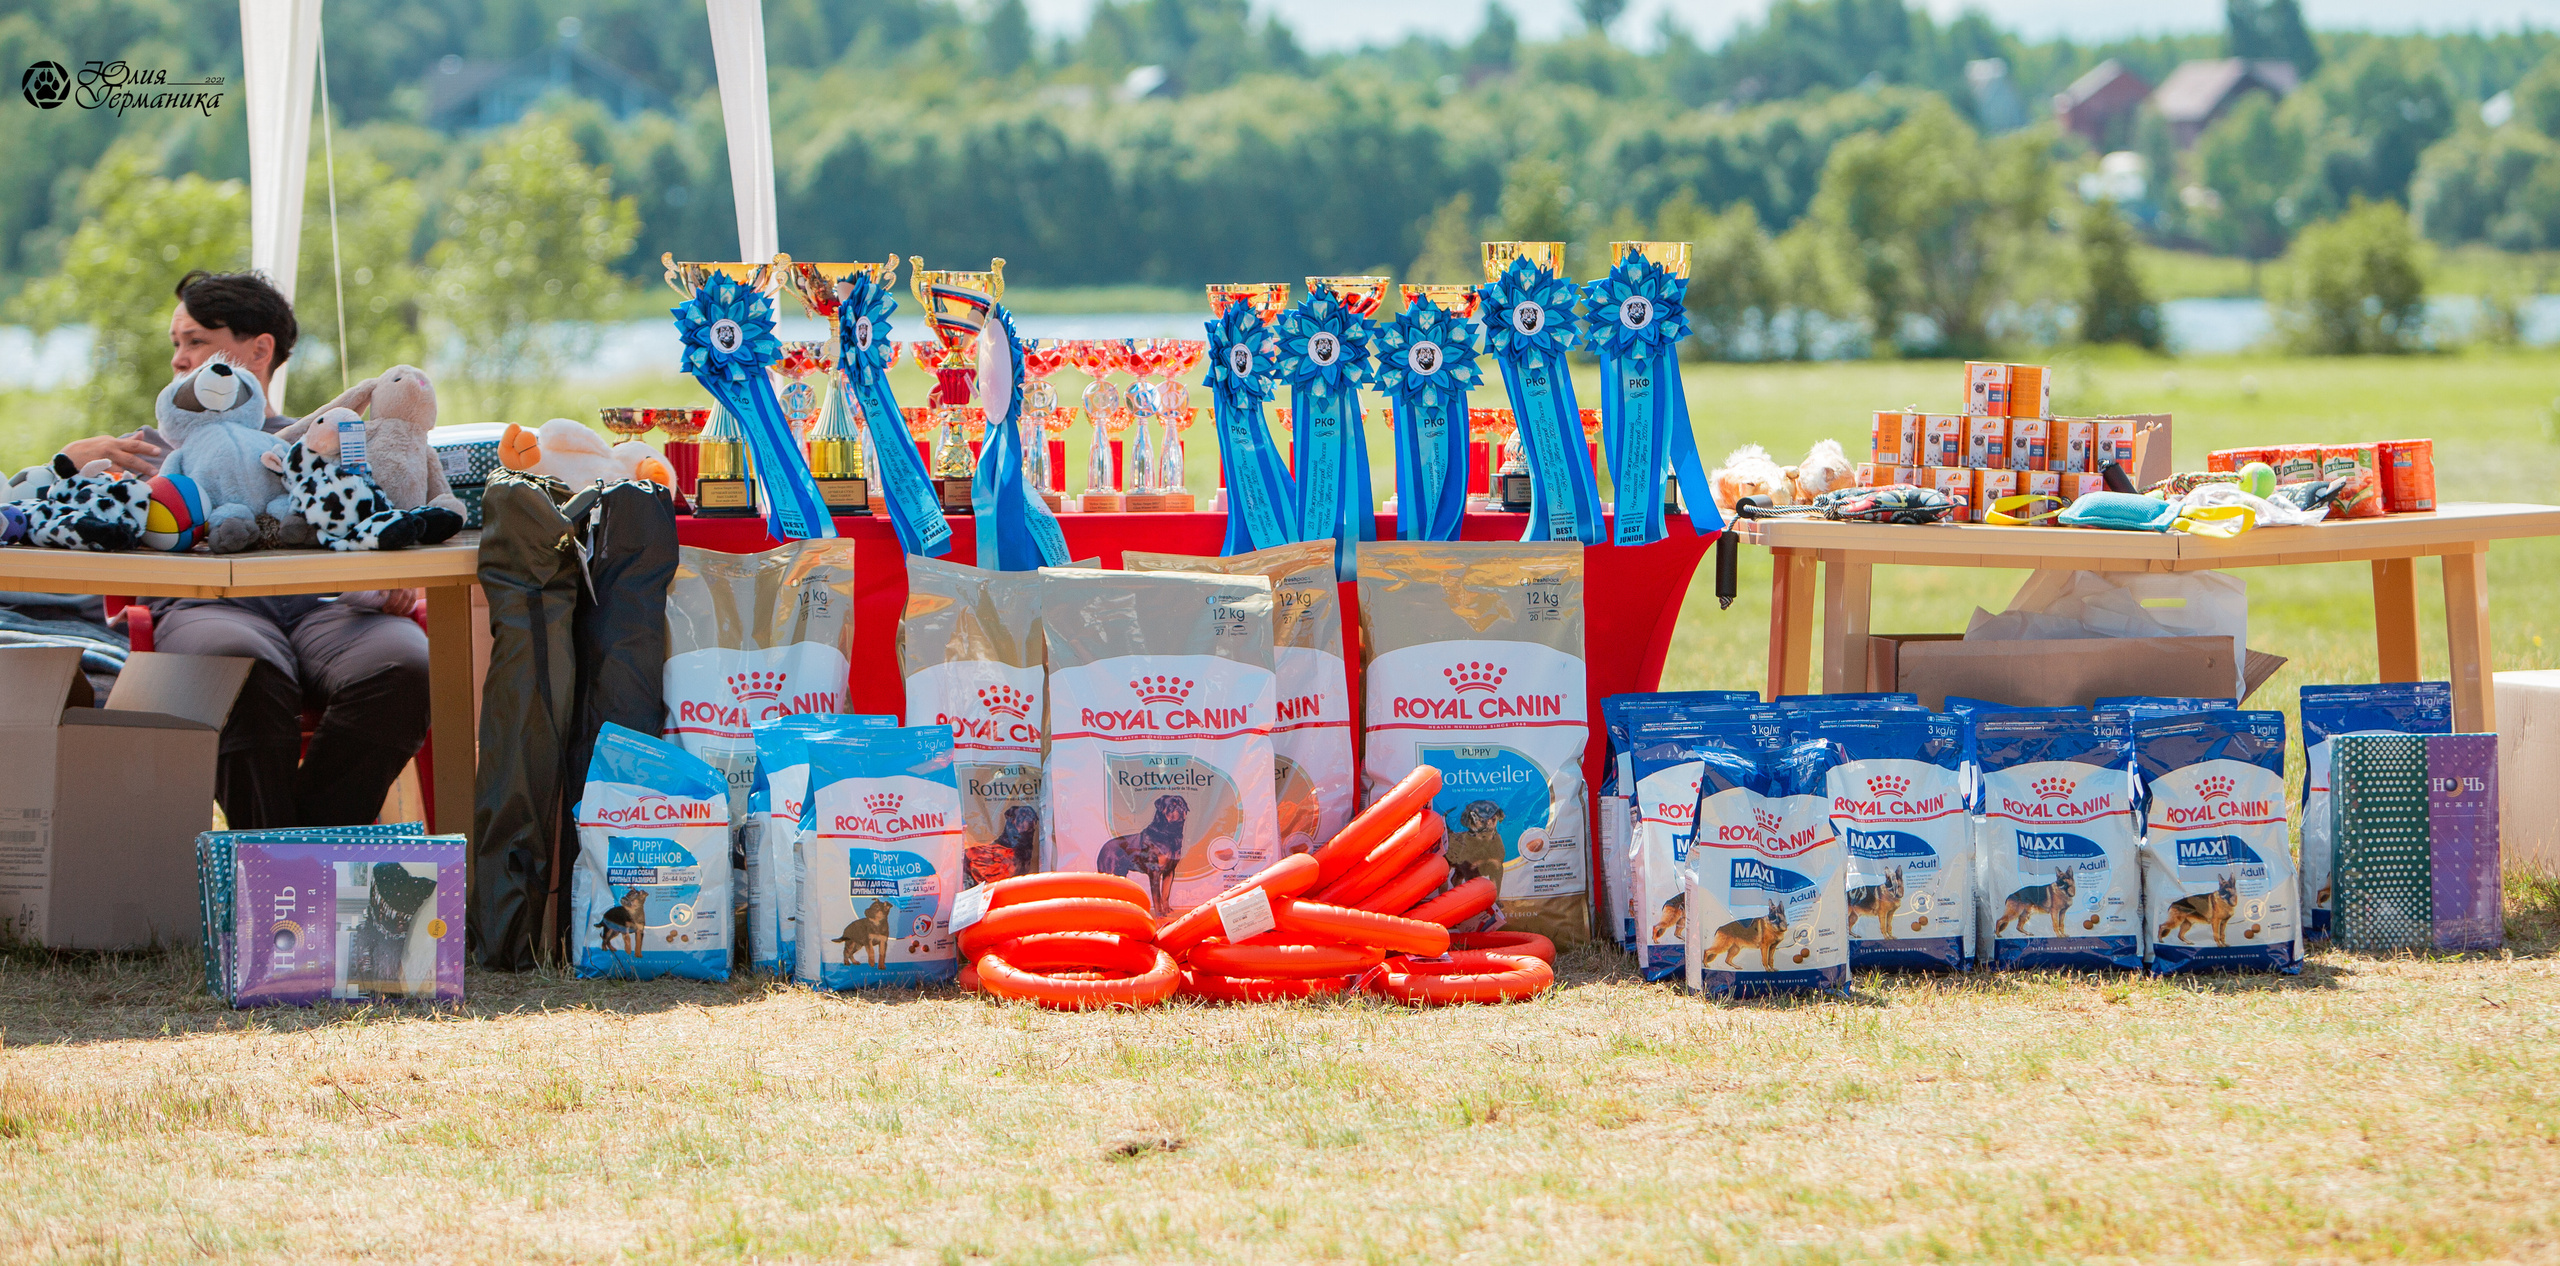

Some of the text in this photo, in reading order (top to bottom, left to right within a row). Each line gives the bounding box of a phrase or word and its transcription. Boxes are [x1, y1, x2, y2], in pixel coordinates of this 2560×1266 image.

[1526, 376, 1546, 388] РКФ
[1629, 378, 1650, 389] РКФ
[1314, 417, 1336, 428] РКФ
[1423, 417, 1445, 429] РКФ
[1230, 424, 1248, 437] РКФ
[783, 521, 805, 529] BEST
[921, 521, 940, 535] BEST
[1555, 526, 1573, 535] BEST
[1623, 525, 1641, 534] BEST
[785, 529, 809, 538] MALE
[921, 524, 949, 544] FEMALE
[1619, 533, 1644, 544] JUNIOR
[798, 588, 828, 605] 12 kg
[1279, 591, 1312, 607] 12 kg
[1526, 590, 1560, 607] 12 kg
[1212, 606, 1246, 622] 12 kg
[1283, 616, 1293, 624] 27
[1529, 613, 1539, 622] 20
[1215, 627, 1225, 636] 27
[1276, 693, 1321, 722] NIN
[1393, 694, 1561, 720] ROYAL CANIN
[2413, 697, 2445, 708] 3 kg/кг
[680, 691, 835, 728] ROYAL CANIN
[1081, 704, 1248, 730] ROYAL CANIN
[935, 712, 1005, 743] ROYAL
[1751, 724, 1781, 736] 3 kg/кг
[1927, 725, 1958, 737] 3 kg/кг
[2093, 726, 2123, 738] 3 kg/кг
[2249, 724, 2280, 737] 3 kg/кг
[917, 739, 947, 752] 3 kg/кг
[1461, 747, 1492, 757] PUPPY
[1148, 757, 1180, 766] ADULT
[1792, 757, 1798, 767] 3
[997, 767, 1027, 776] ADULT
[1117, 767, 1215, 788] Rottweiler
[968, 778, 1042, 798] Rottweil
[1658, 802, 1696, 818] ROY
[1834, 794, 1944, 816] ROYAL CANIN
[2003, 793, 2111, 818] ROYAL CANIN
[597, 802, 711, 823] ROYAL CANIN
[2166, 800, 2269, 824] ROYAL CANIN
[835, 812, 946, 834] ROYAL CANIN
[1719, 824, 1816, 852] ROYAL CANIN
[1850, 832, 1896, 850] MAXI
[2019, 834, 2065, 851] MAXI
[632, 840, 664, 852] PUPPY
[2180, 839, 2228, 858] MAXI
[612, 851, 682, 865] ДЛЯ ЩЕНКОВ
[873, 852, 900, 865] PUPPY
[1908, 858, 1937, 870] Adult
[854, 863, 922, 877] ДЛЯ ЩЕНКОВ
[2078, 859, 2107, 871] Adult
[610, 868, 623, 876] MAXI
[626, 869, 638, 877] ДЛЯ
[1734, 862, 1775, 884] MAXI
[2240, 867, 2266, 877] Adult
[608, 876, 657, 884] КРУПНЫХ РАЗМЕРОВ
[661, 875, 696, 884] 26-44 kg/кг
[853, 880, 867, 888] MAXI
[881, 880, 896, 888] СОБАК
[902, 884, 936, 894] 26-44 kg/кг
[1789, 889, 1817, 905] Adult
[1503, 910, 1539, 918] TRITION
[307, 887, 316, 970] нежна
